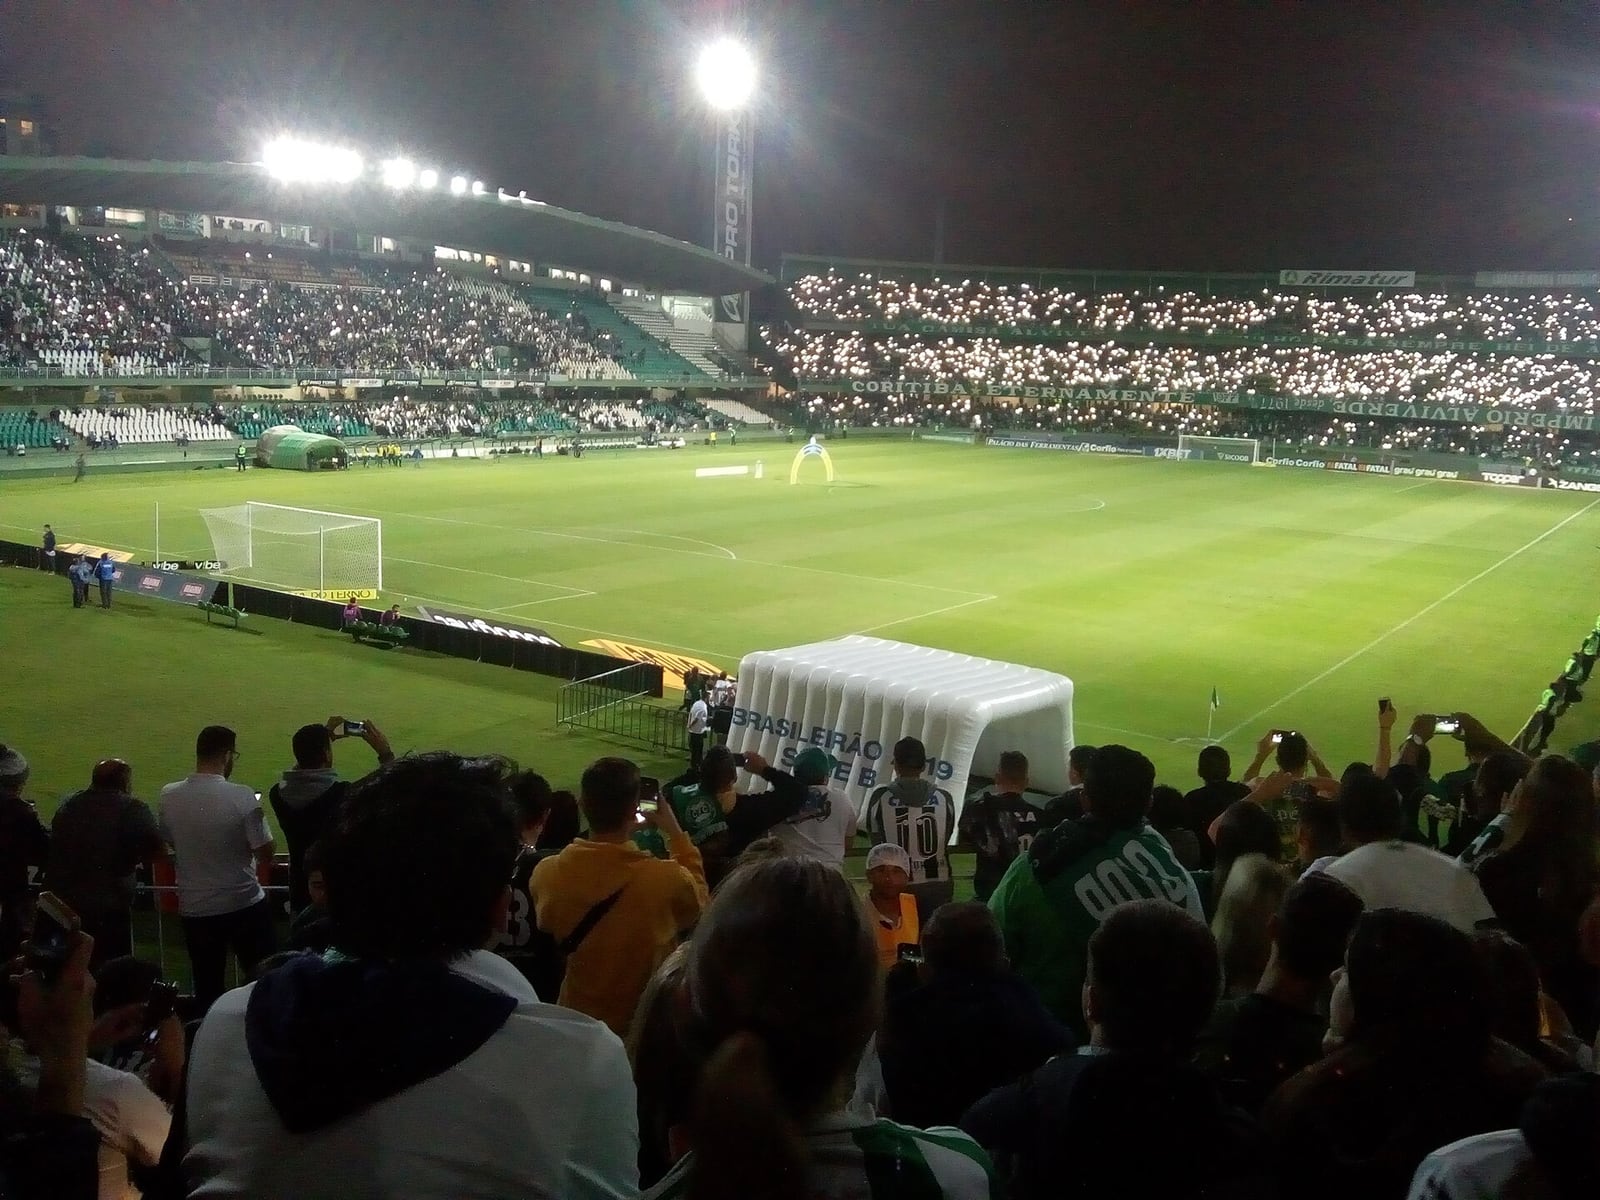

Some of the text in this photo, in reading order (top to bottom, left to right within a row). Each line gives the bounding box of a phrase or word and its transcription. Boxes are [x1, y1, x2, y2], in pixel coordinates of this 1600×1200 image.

[1301, 272, 1408, 286] Rimatur
[852, 381, 967, 395] CORITIBA
[986, 384, 1196, 403] ETERNAMENTE
[1265, 456, 1325, 468] Corfio Corfio
[1334, 462, 1358, 471] FATAL
[1366, 464, 1391, 474] FATAL
[153, 560, 179, 572] vibe
[194, 560, 221, 570] vibe
[732, 707, 882, 761] BRASILEIRÃO
[896, 811, 938, 859] 10
